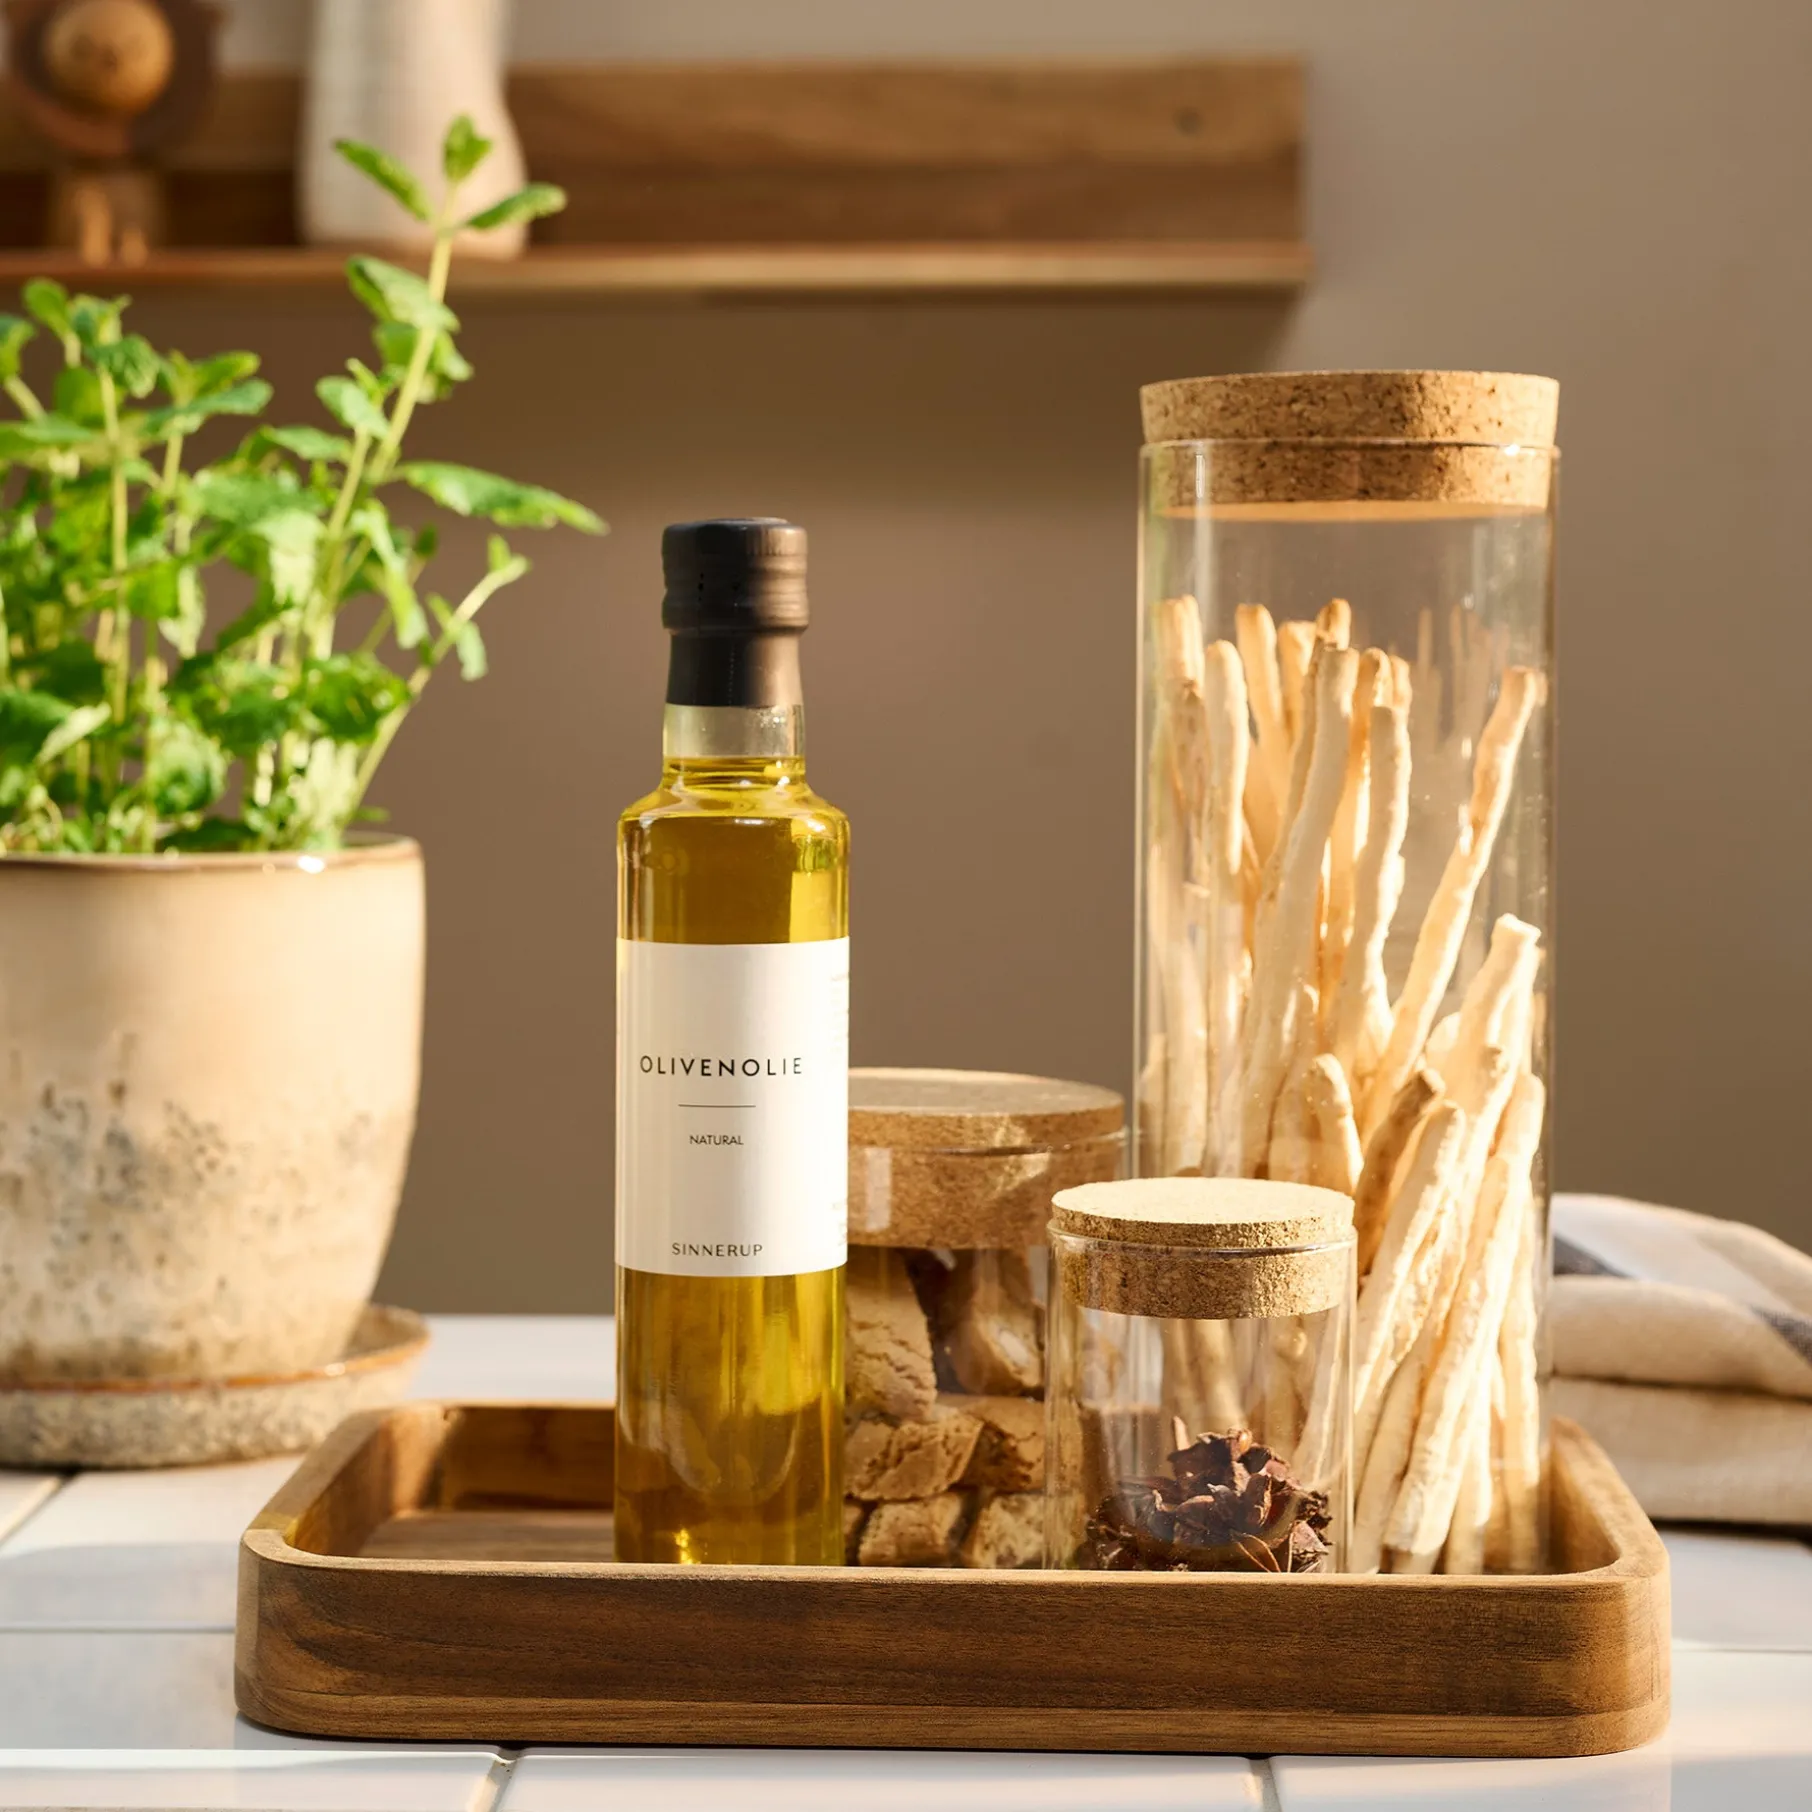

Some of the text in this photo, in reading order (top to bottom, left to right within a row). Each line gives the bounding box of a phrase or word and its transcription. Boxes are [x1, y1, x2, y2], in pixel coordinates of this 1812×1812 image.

[639, 1054, 803, 1077] OLIVENOLIE
[689, 1134, 744, 1146] NATURAL
[671, 1242, 764, 1257] SINNERUP
